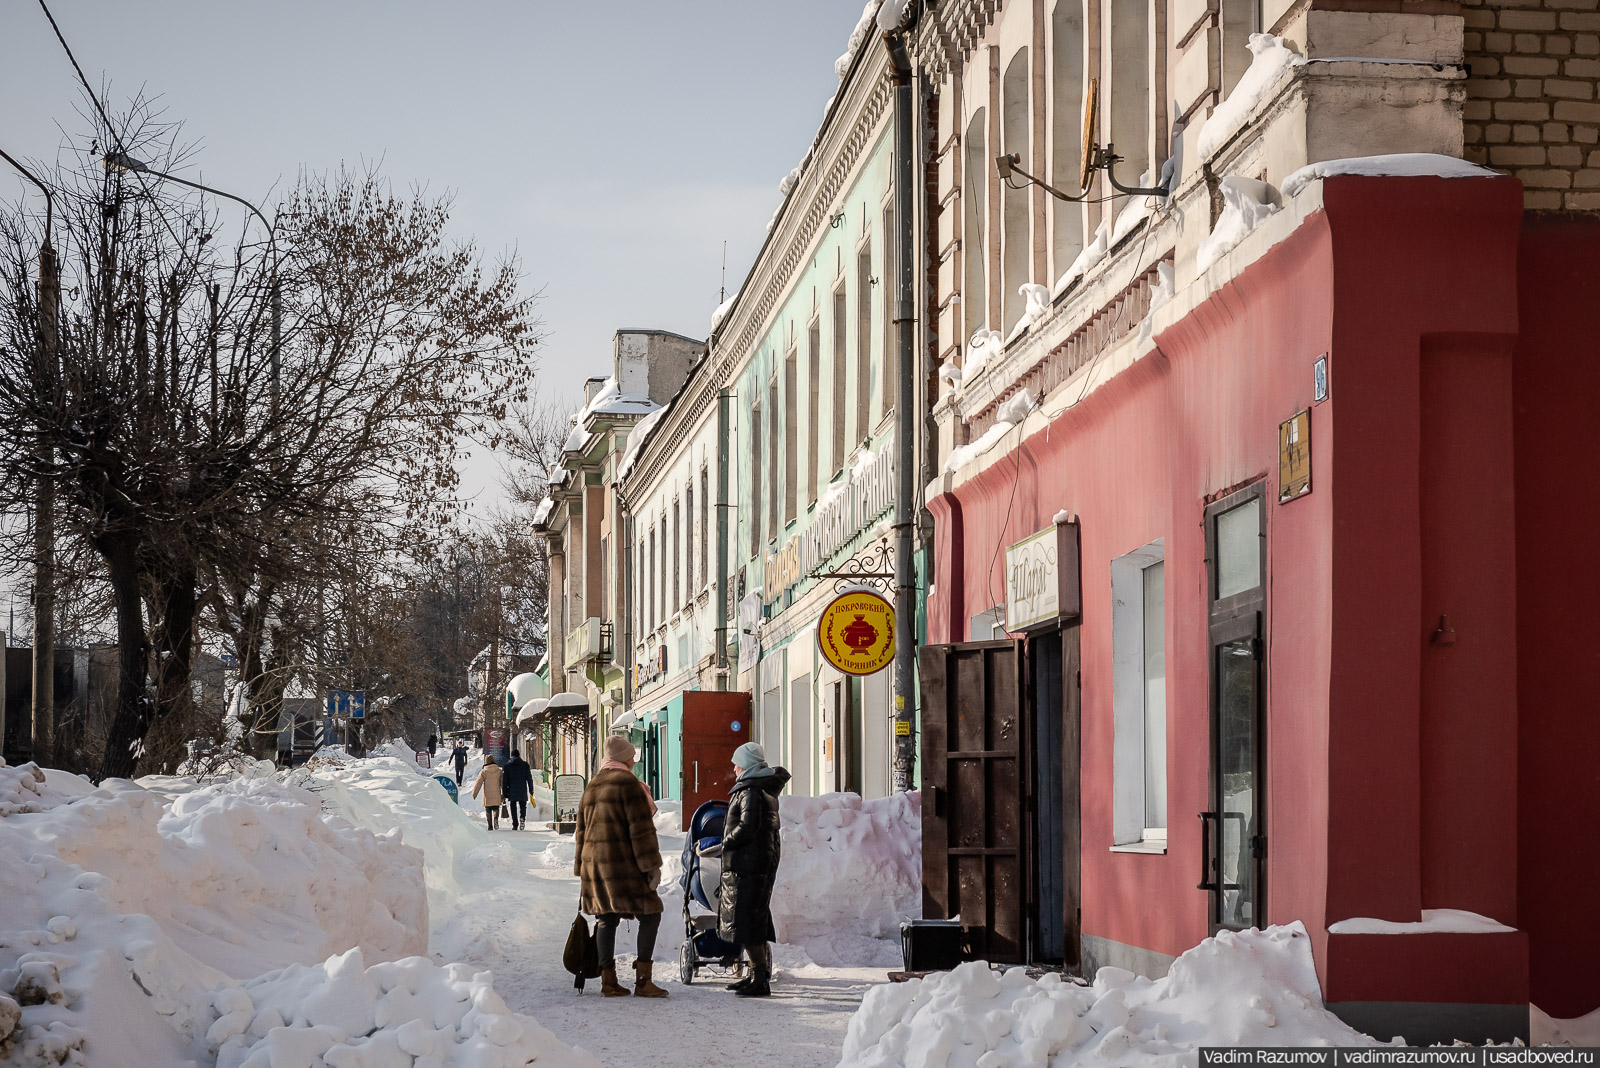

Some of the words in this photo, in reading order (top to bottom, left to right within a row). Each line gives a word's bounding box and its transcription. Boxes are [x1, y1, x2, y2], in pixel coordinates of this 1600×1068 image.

[1316, 361, 1325, 398] 96
[854, 443, 894, 532] ПРЯНИК
[835, 602, 885, 613] ПОКРОВСКИЙ
[843, 659, 877, 670] ПРЯНИК
